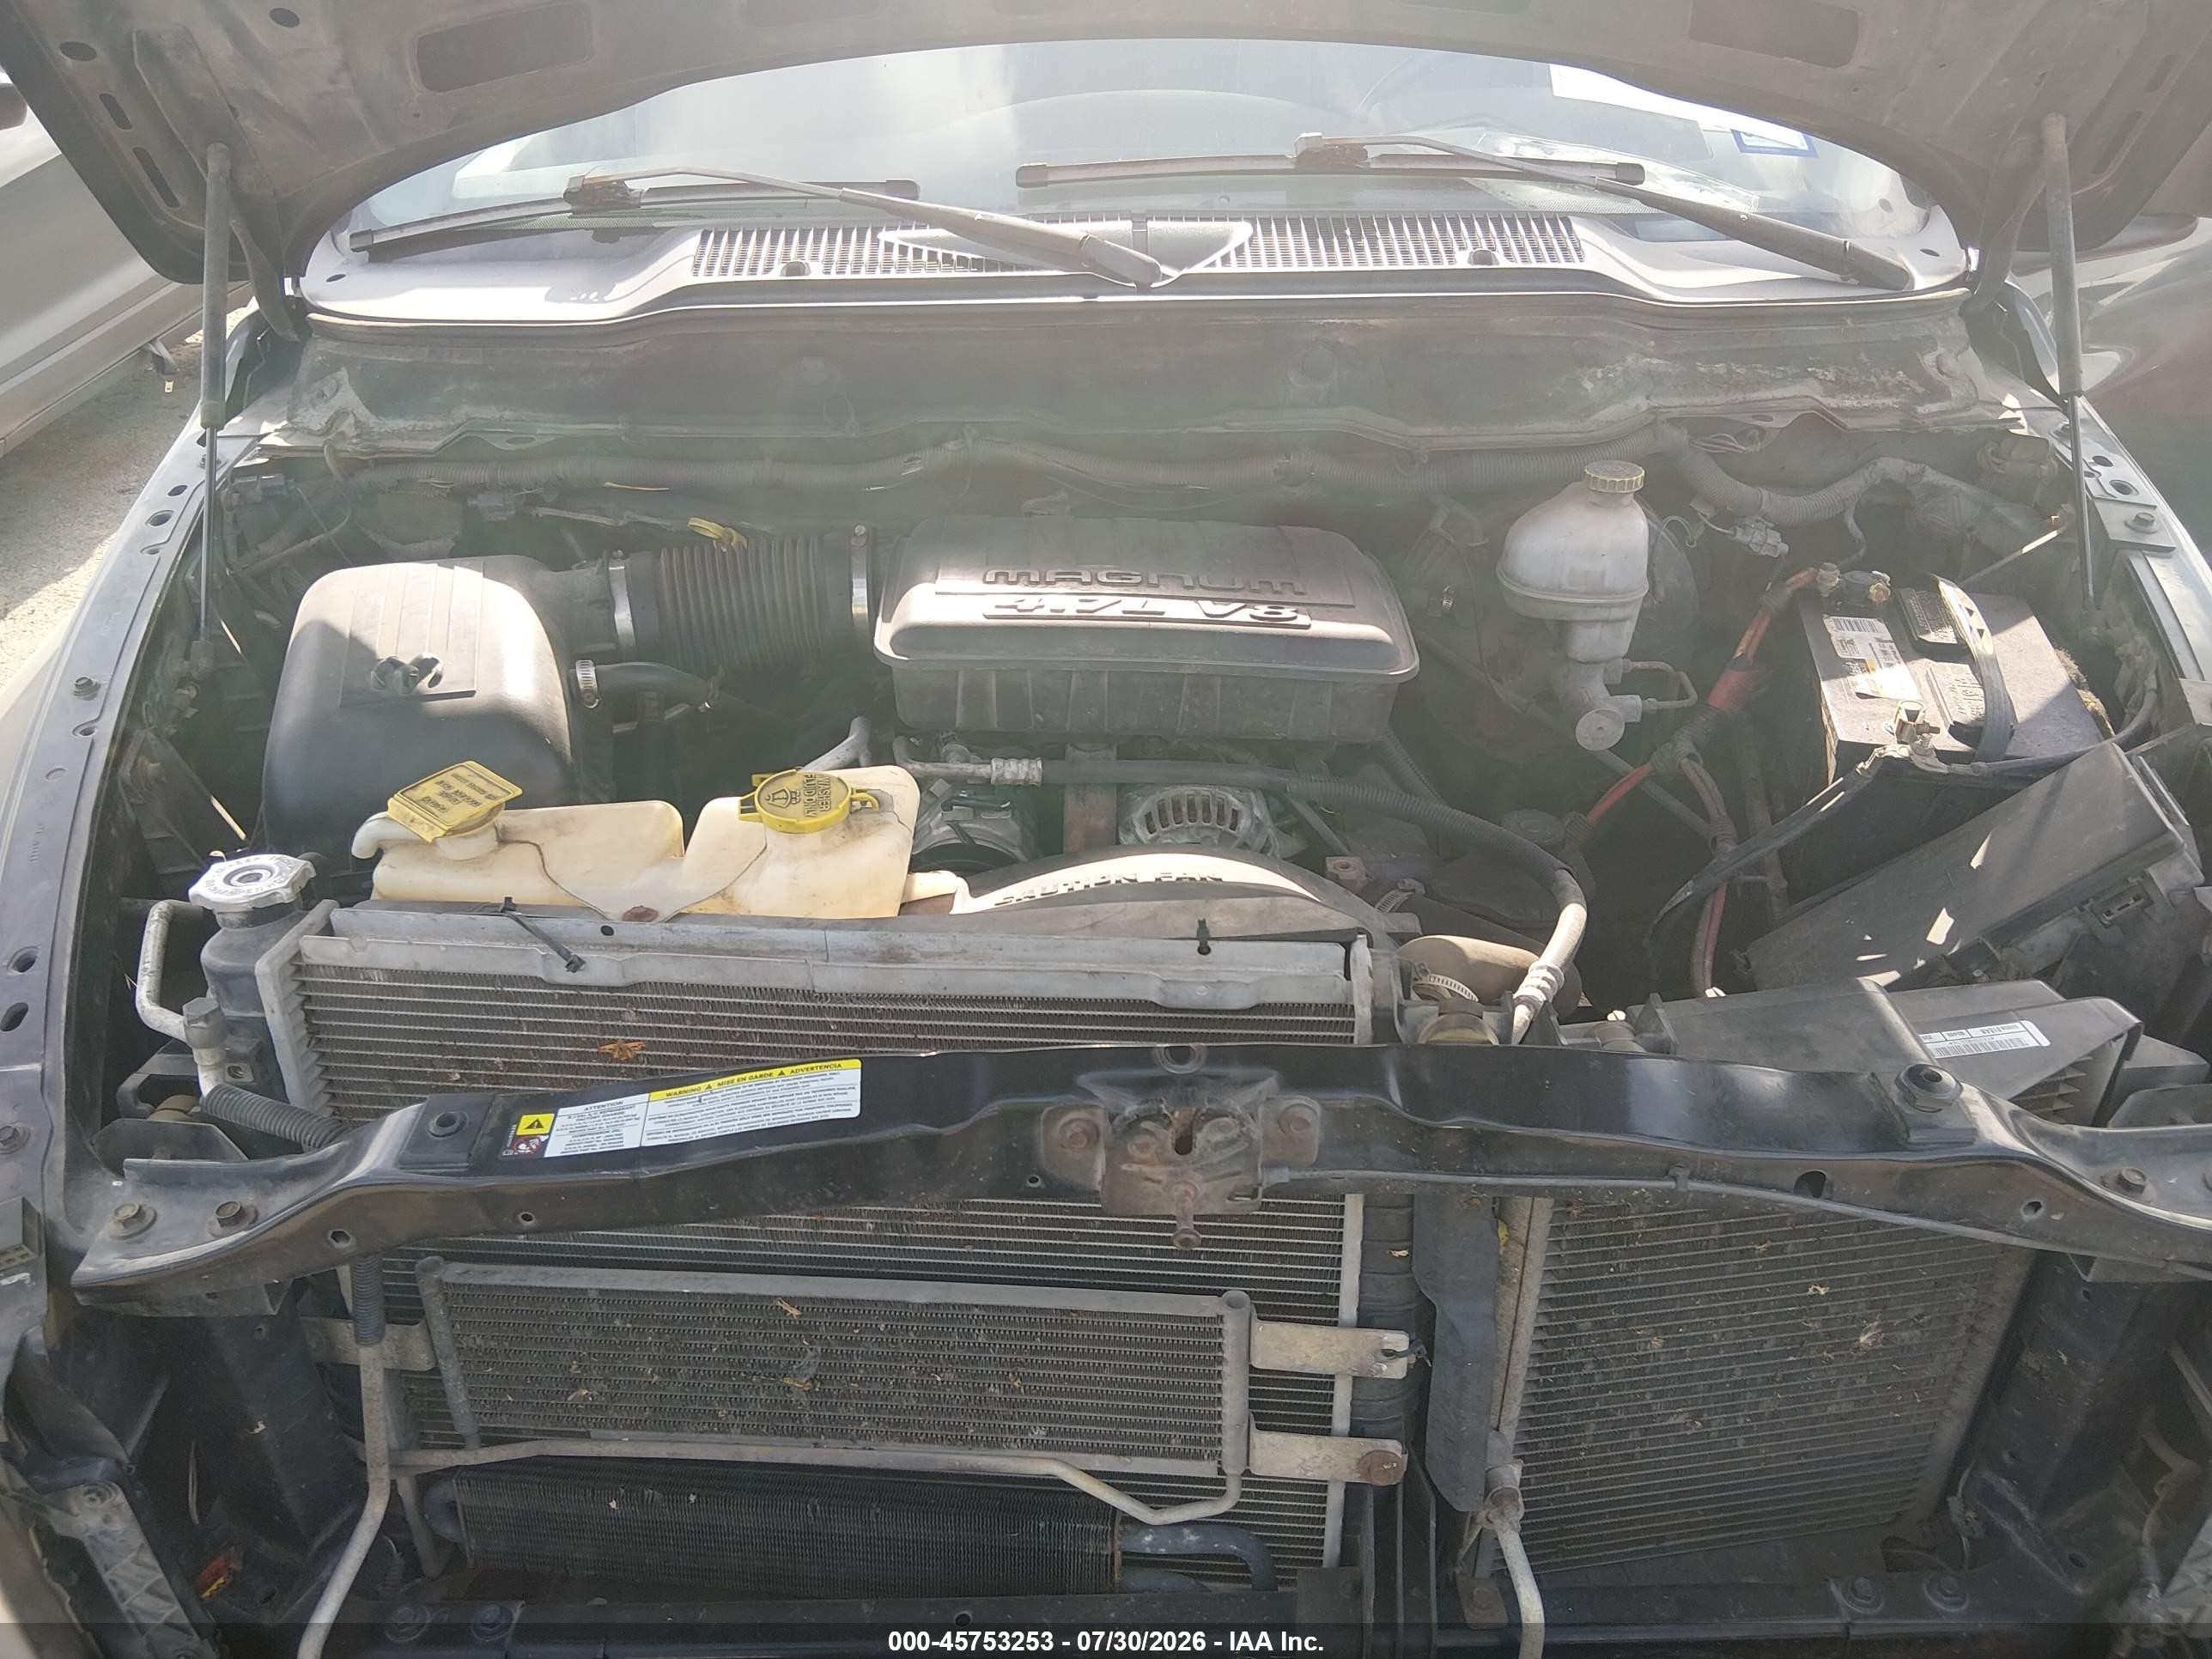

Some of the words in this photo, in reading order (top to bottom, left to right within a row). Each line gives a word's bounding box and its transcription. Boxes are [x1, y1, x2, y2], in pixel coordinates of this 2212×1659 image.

[983, 568, 1307, 595] MAGNUM
[1194, 598, 1299, 622] V8
[804, 772, 816, 797] FLUID
[817, 773, 831, 812] WASHER
[804, 798, 816, 817] ONLY
[665, 1086, 702, 1098] WARNING
[717, 1078, 736, 1088] MISE
[749, 1072, 773, 1082] GARDE
[790, 1062, 842, 1074] ADVERTENCIA
[583, 1100, 624, 1111] ATTENTION
